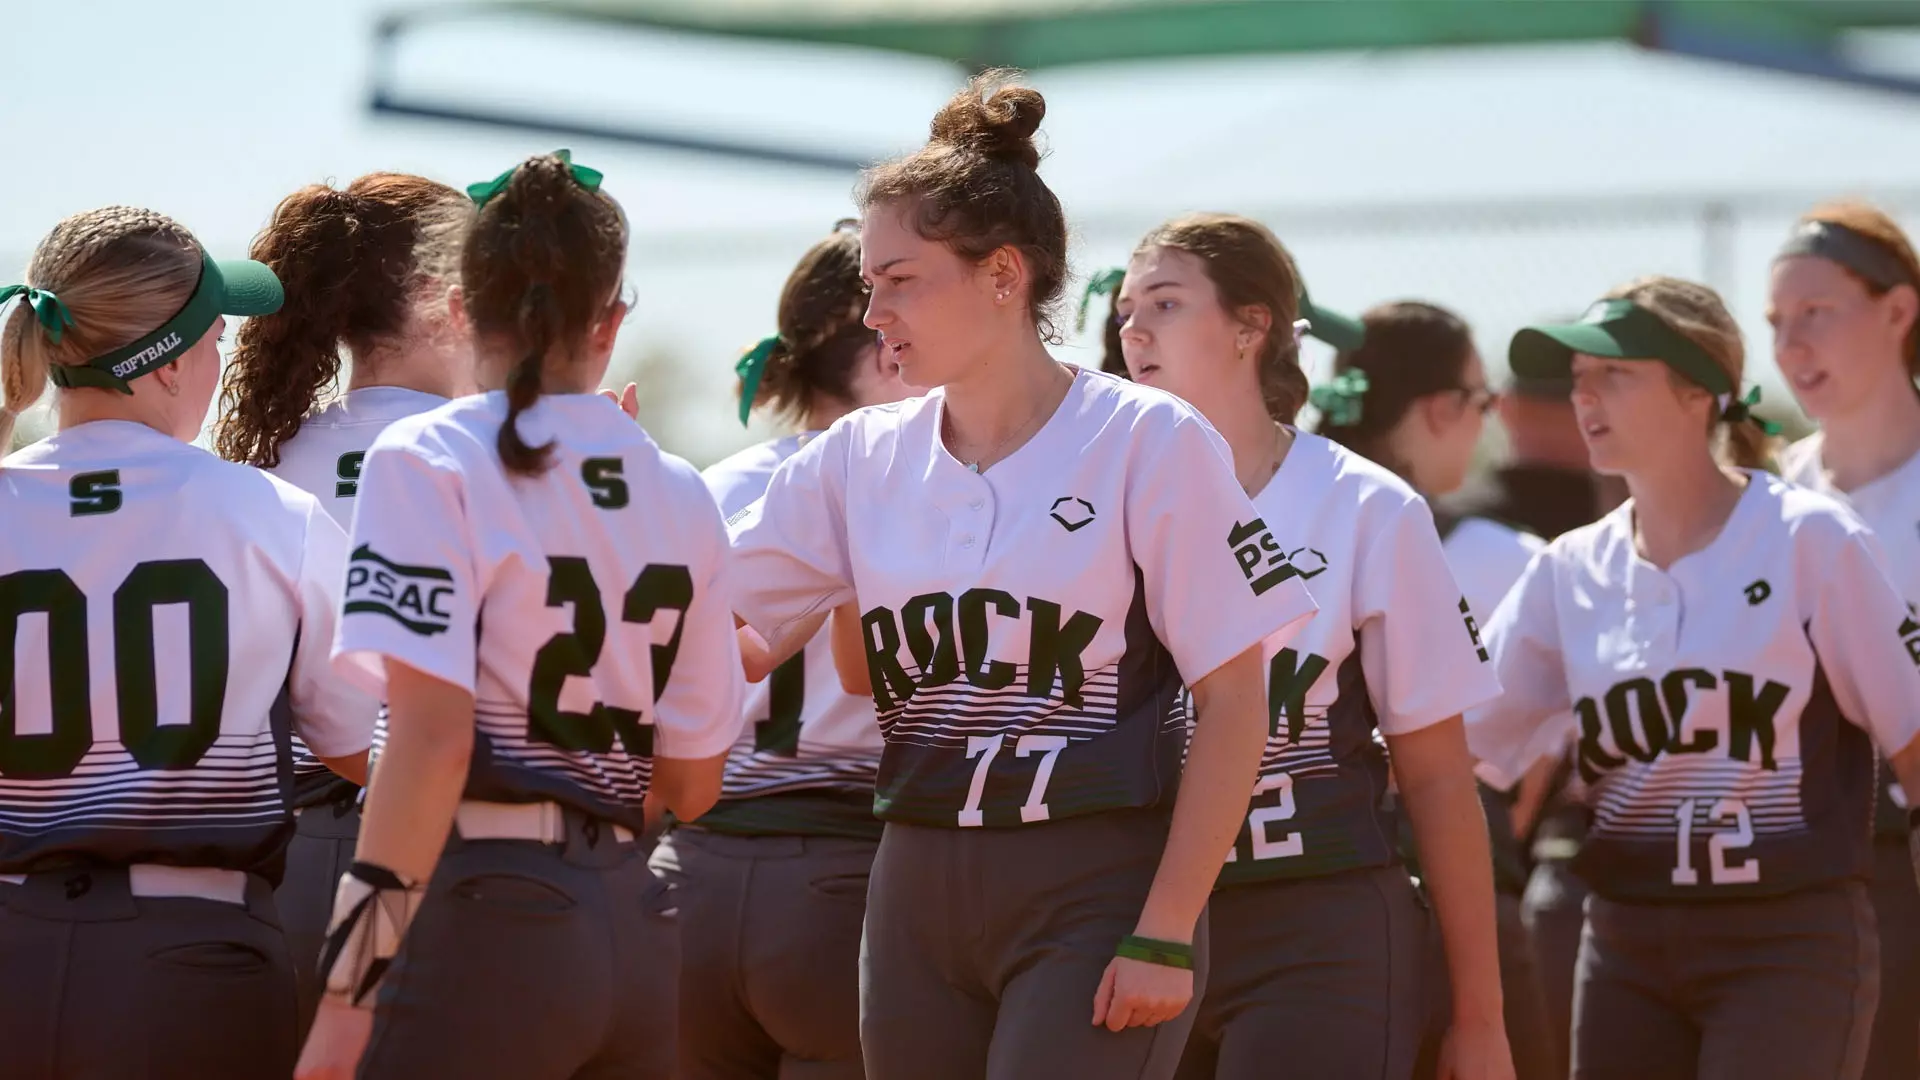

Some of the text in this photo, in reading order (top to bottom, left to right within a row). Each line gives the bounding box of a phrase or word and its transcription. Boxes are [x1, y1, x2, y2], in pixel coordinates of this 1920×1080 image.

[112, 332, 182, 378] SOFTBALL
[69, 469, 122, 517] S
[334, 451, 366, 498] S
[582, 457, 630, 510] S
[1234, 532, 1287, 580] PS
[345, 566, 455, 619] PSAC
[0, 558, 230, 779] 00
[861, 588, 1104, 711] ROCK
[1573, 668, 1791, 785] ROCK
[957, 734, 1068, 828] 77
[1224, 772, 1304, 862] 2
[1671, 799, 1760, 885] 12
